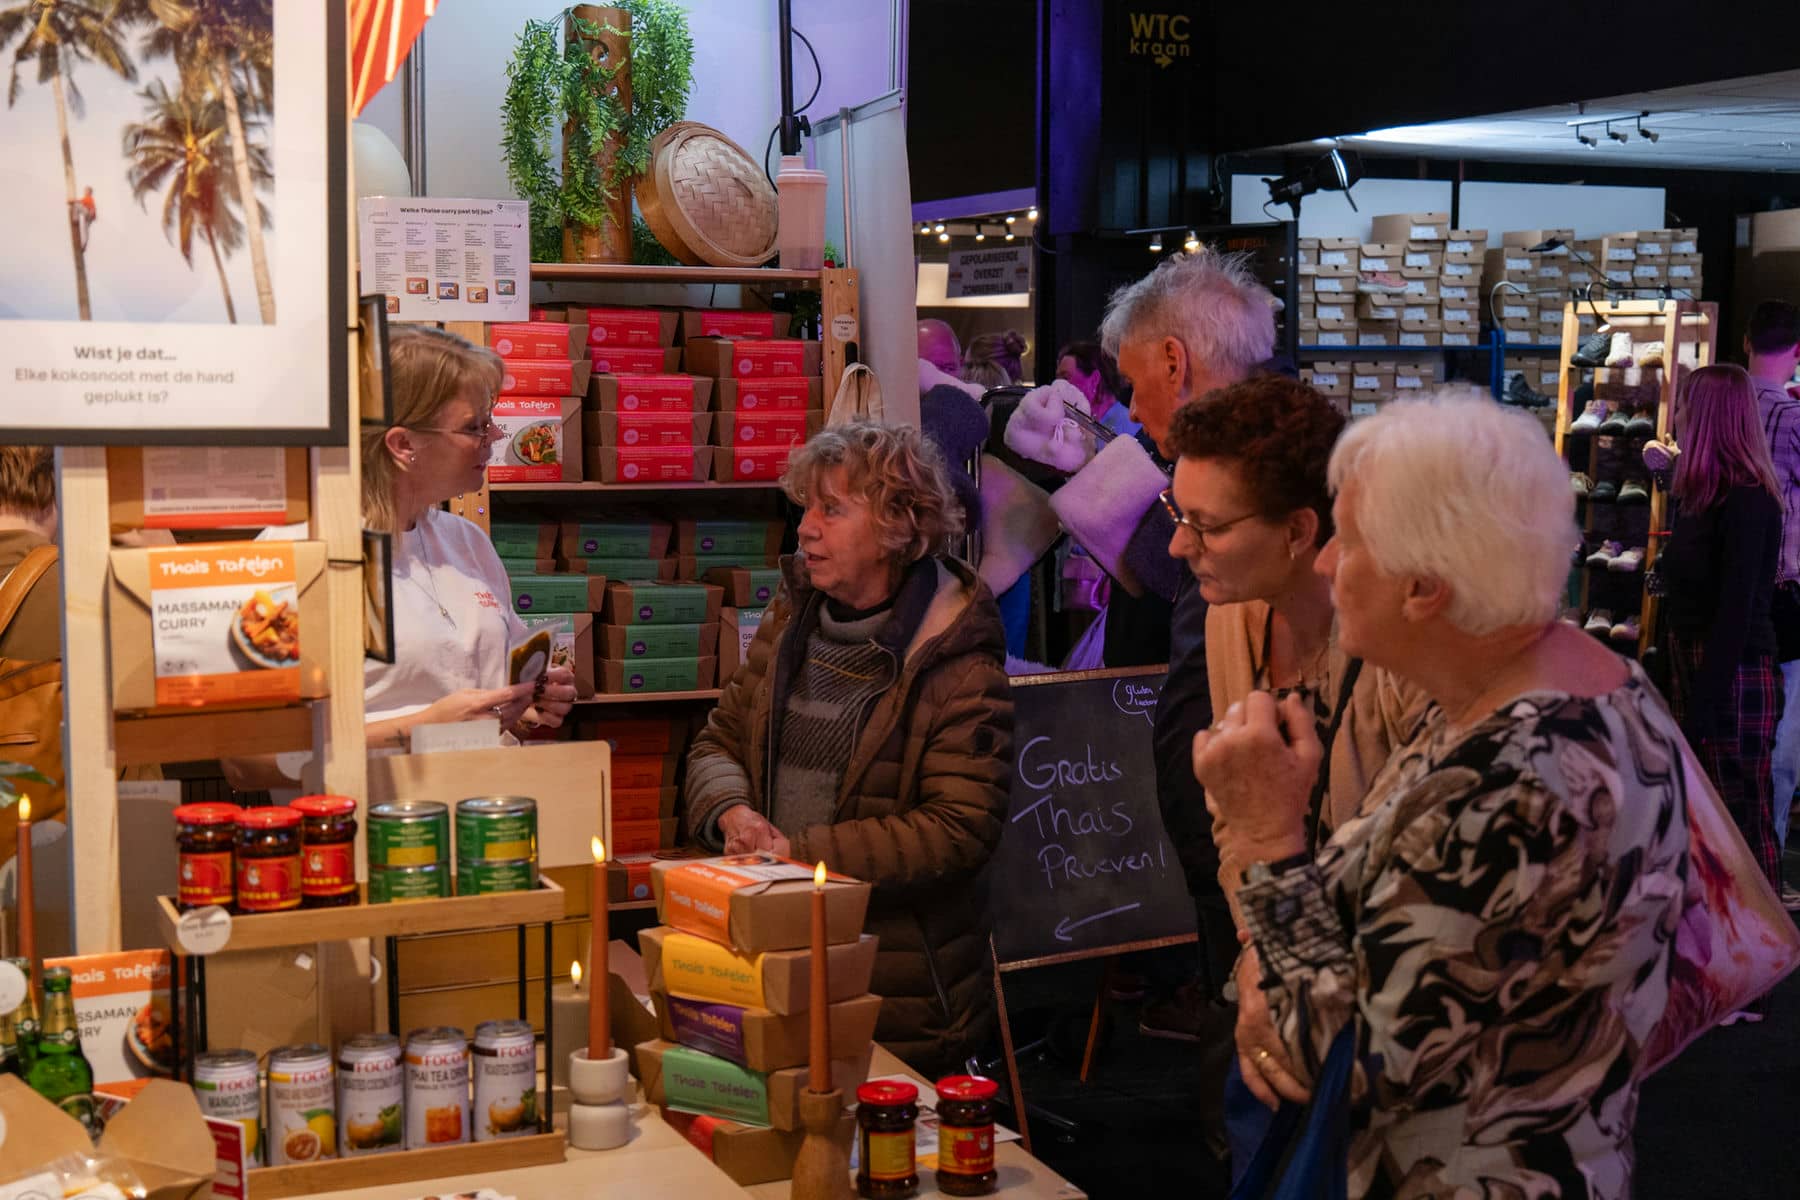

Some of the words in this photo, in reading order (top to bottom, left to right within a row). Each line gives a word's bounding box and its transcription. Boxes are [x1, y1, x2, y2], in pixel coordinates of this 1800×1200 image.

[1130, 14, 1189, 40] WTC
[1130, 38, 1189, 56] kraan
[74, 346, 112, 360] Wist
[116, 346, 133, 363] je
[136, 347, 177, 361] dat...
[14, 368, 48, 381] Elke
[51, 368, 135, 383] kokosnoot
[139, 370, 169, 383] met
[173, 370, 194, 383] de
[196, 370, 234, 384] hand
[84, 389, 144, 405] geplukt
[148, 390, 169, 402] is?
[520, 400, 555, 411] Tafelen
[160, 560, 210, 575] Thais
[217, 556, 283, 576] Tafelen
[158, 600, 243, 614] MASSAMAN
[159, 619, 207, 630] CURRY
[1012, 793, 1133, 839] Thais
[673, 959, 704, 975] Thais
[709, 966, 755, 984] Tafelen
[78, 1007, 138, 1023] SSAMAN
[431, 1069, 449, 1082] TEA
[672, 1072, 707, 1088] Thais
[712, 1079, 760, 1100] Tafelen
